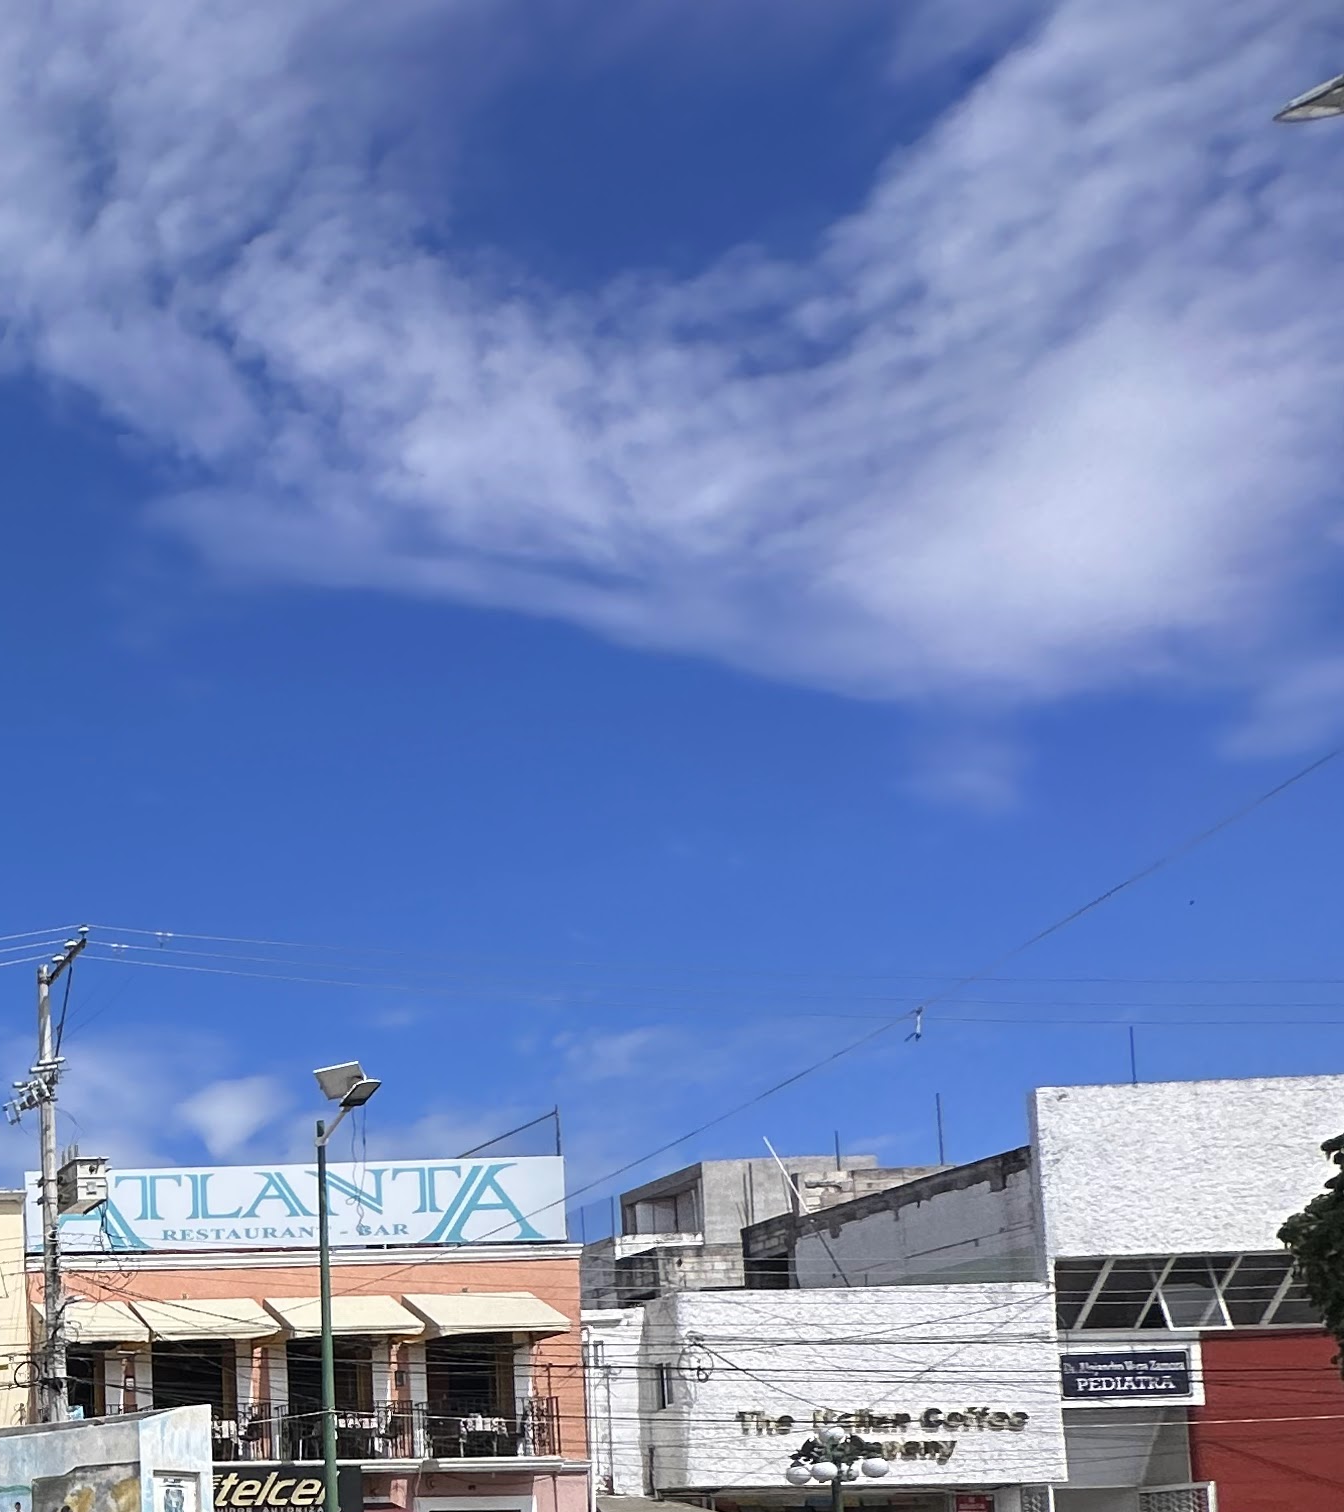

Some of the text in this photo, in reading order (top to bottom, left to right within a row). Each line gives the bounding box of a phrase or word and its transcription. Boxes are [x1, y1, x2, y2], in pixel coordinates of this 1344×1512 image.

[161, 1226, 331, 1241] RESTAURAN
[356, 1223, 410, 1236] BAR
[1075, 1374, 1177, 1392] PEDIATRA
[735, 1410, 794, 1435] The
[919, 1406, 1031, 1433] Coffee
